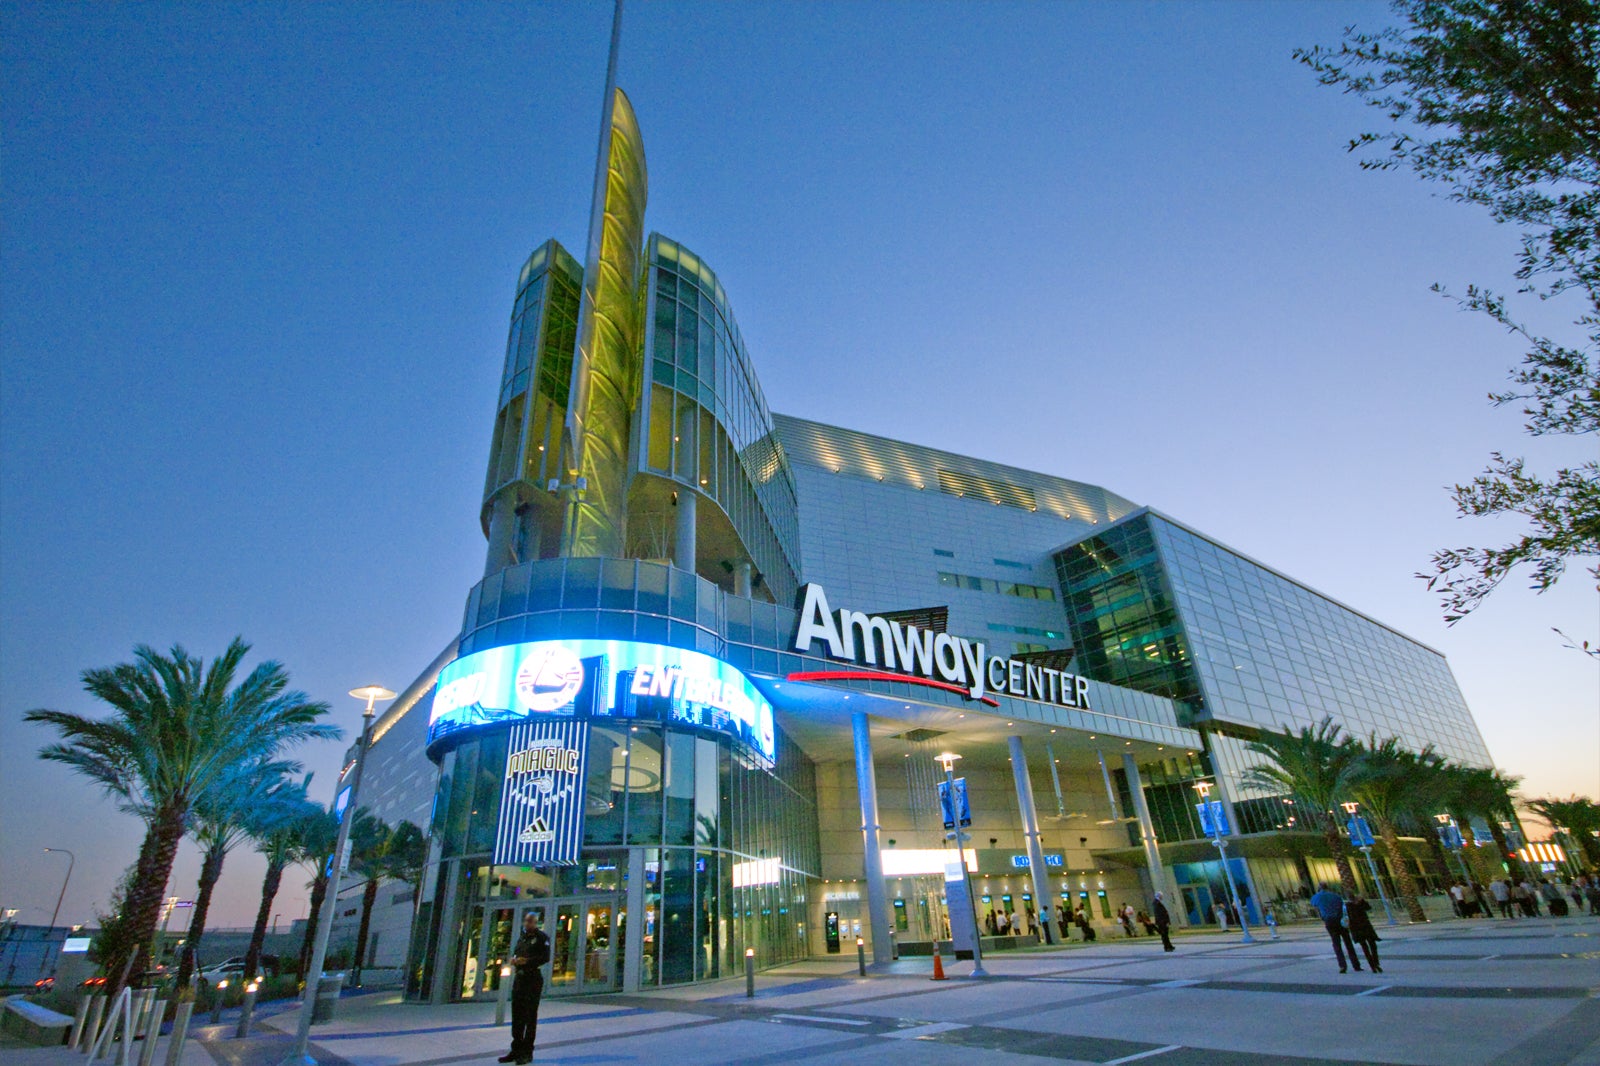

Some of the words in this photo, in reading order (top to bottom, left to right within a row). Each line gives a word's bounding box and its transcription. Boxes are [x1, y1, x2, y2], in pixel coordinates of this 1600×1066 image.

[795, 582, 985, 699] Amway
[988, 656, 1091, 709] CENTER
[507, 747, 579, 779] MAGIC
[520, 830, 553, 842] adidas
